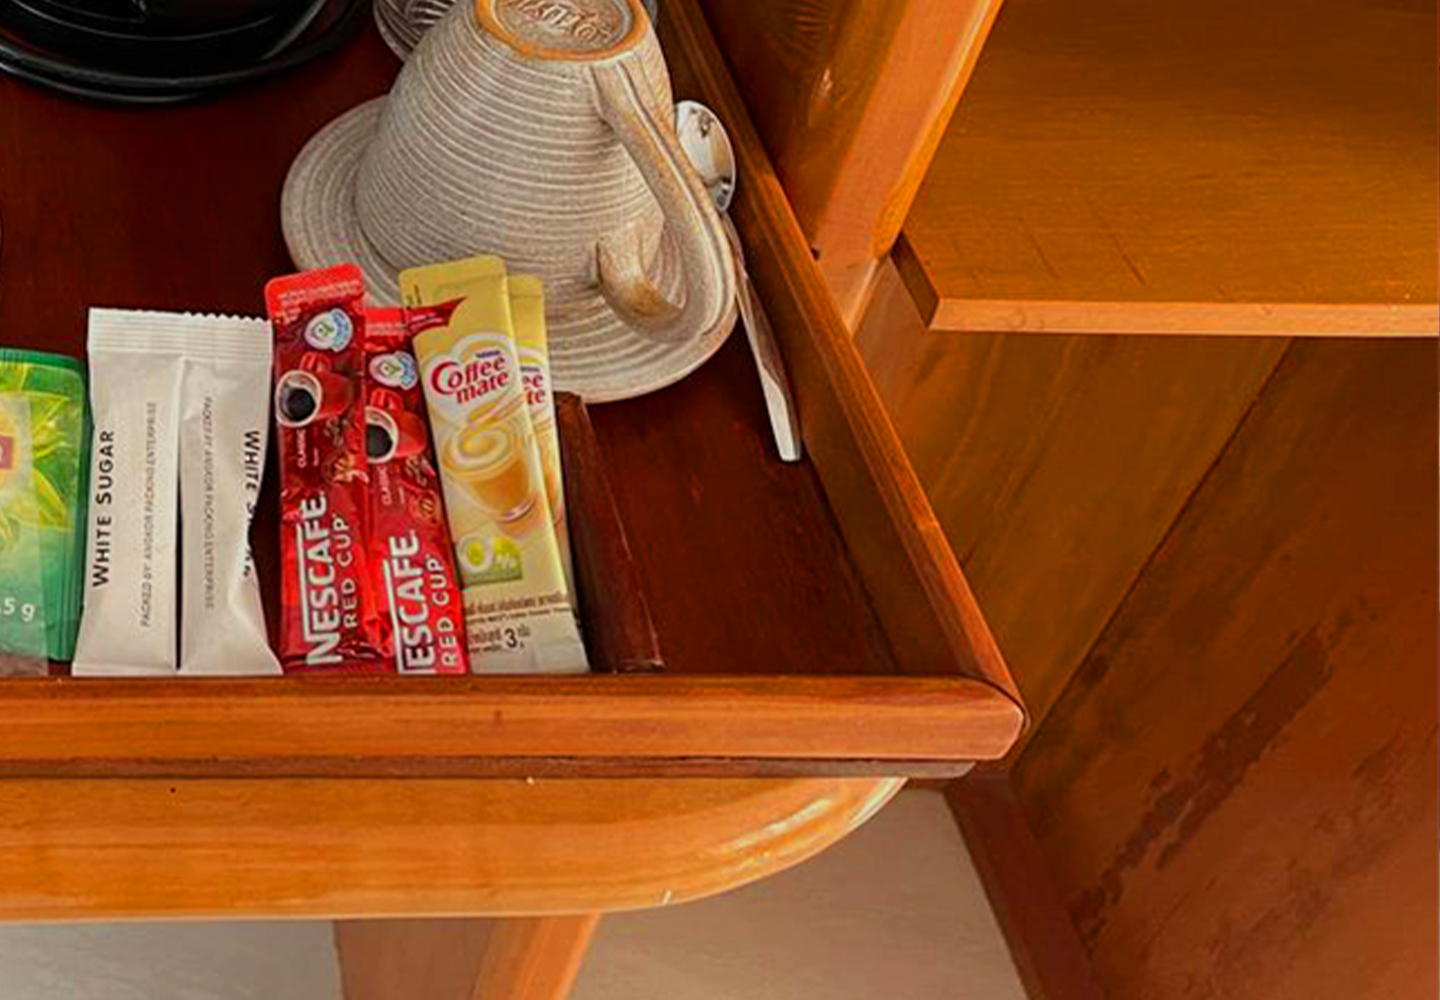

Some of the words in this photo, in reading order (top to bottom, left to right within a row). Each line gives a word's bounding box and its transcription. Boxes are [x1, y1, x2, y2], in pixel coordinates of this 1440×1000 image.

[430, 356, 506, 395] Coffee
[456, 371, 509, 404] mate
[525, 387, 546, 405] te
[145, 401, 156, 466] ENTERPRISE
[95, 429, 114, 505] SUGAR
[204, 449, 214, 491] ANGKOR
[243, 430, 261, 491] WHITE
[144, 467, 155, 513] PACKING
[93, 516, 112, 588] WHITE
[143, 515, 154, 560] ANGKOR
[331, 516, 352, 568] CUP
[204, 542, 215, 610] ENTERPRISE
[425, 556, 449, 606] CUP
[22, 602, 36, 620] g
[140, 581, 152, 628] PACKED
[340, 577, 358, 629] RED
[436, 617, 458, 667] RED
[504, 627, 518, 649] 3
